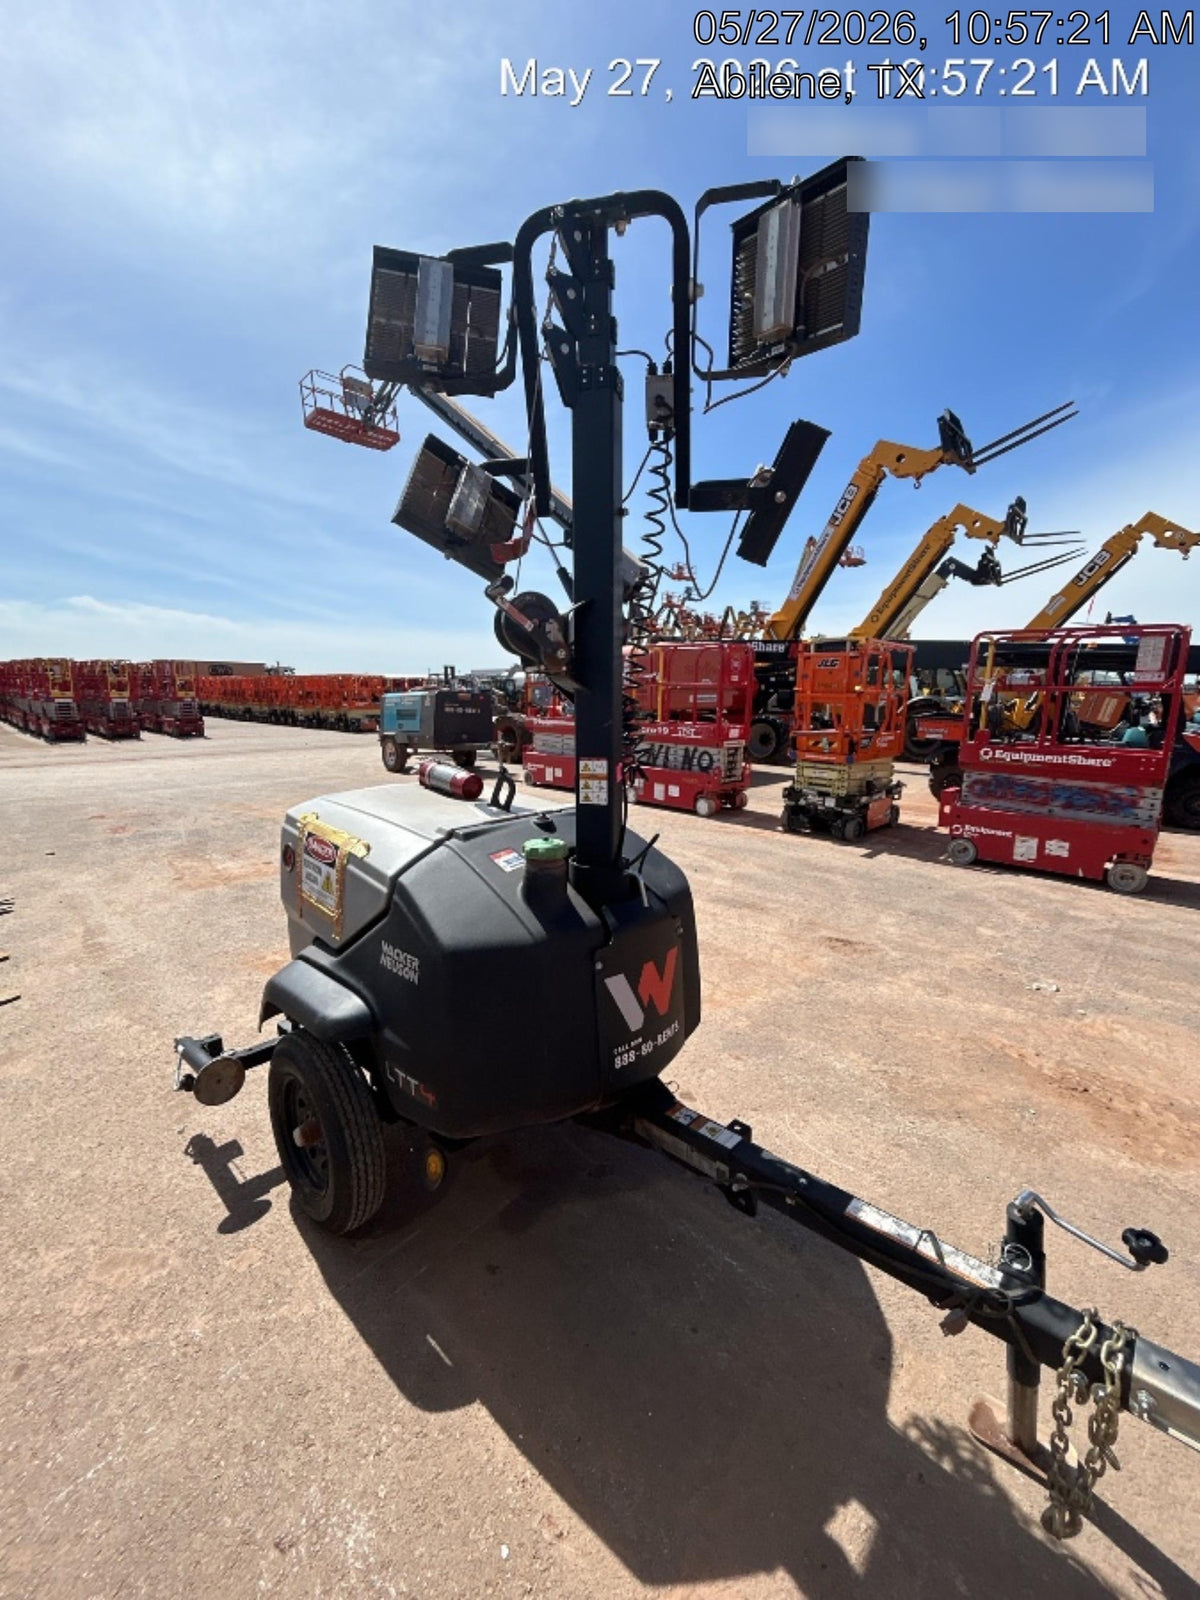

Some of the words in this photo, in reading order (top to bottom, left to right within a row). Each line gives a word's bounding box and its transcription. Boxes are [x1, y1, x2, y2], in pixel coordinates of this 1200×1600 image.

[830, 484, 859, 527] JCB
[1073, 550, 1111, 587] JCB
[817, 657, 839, 669] JLG
[994, 749, 1113, 767] EquipmentShare
